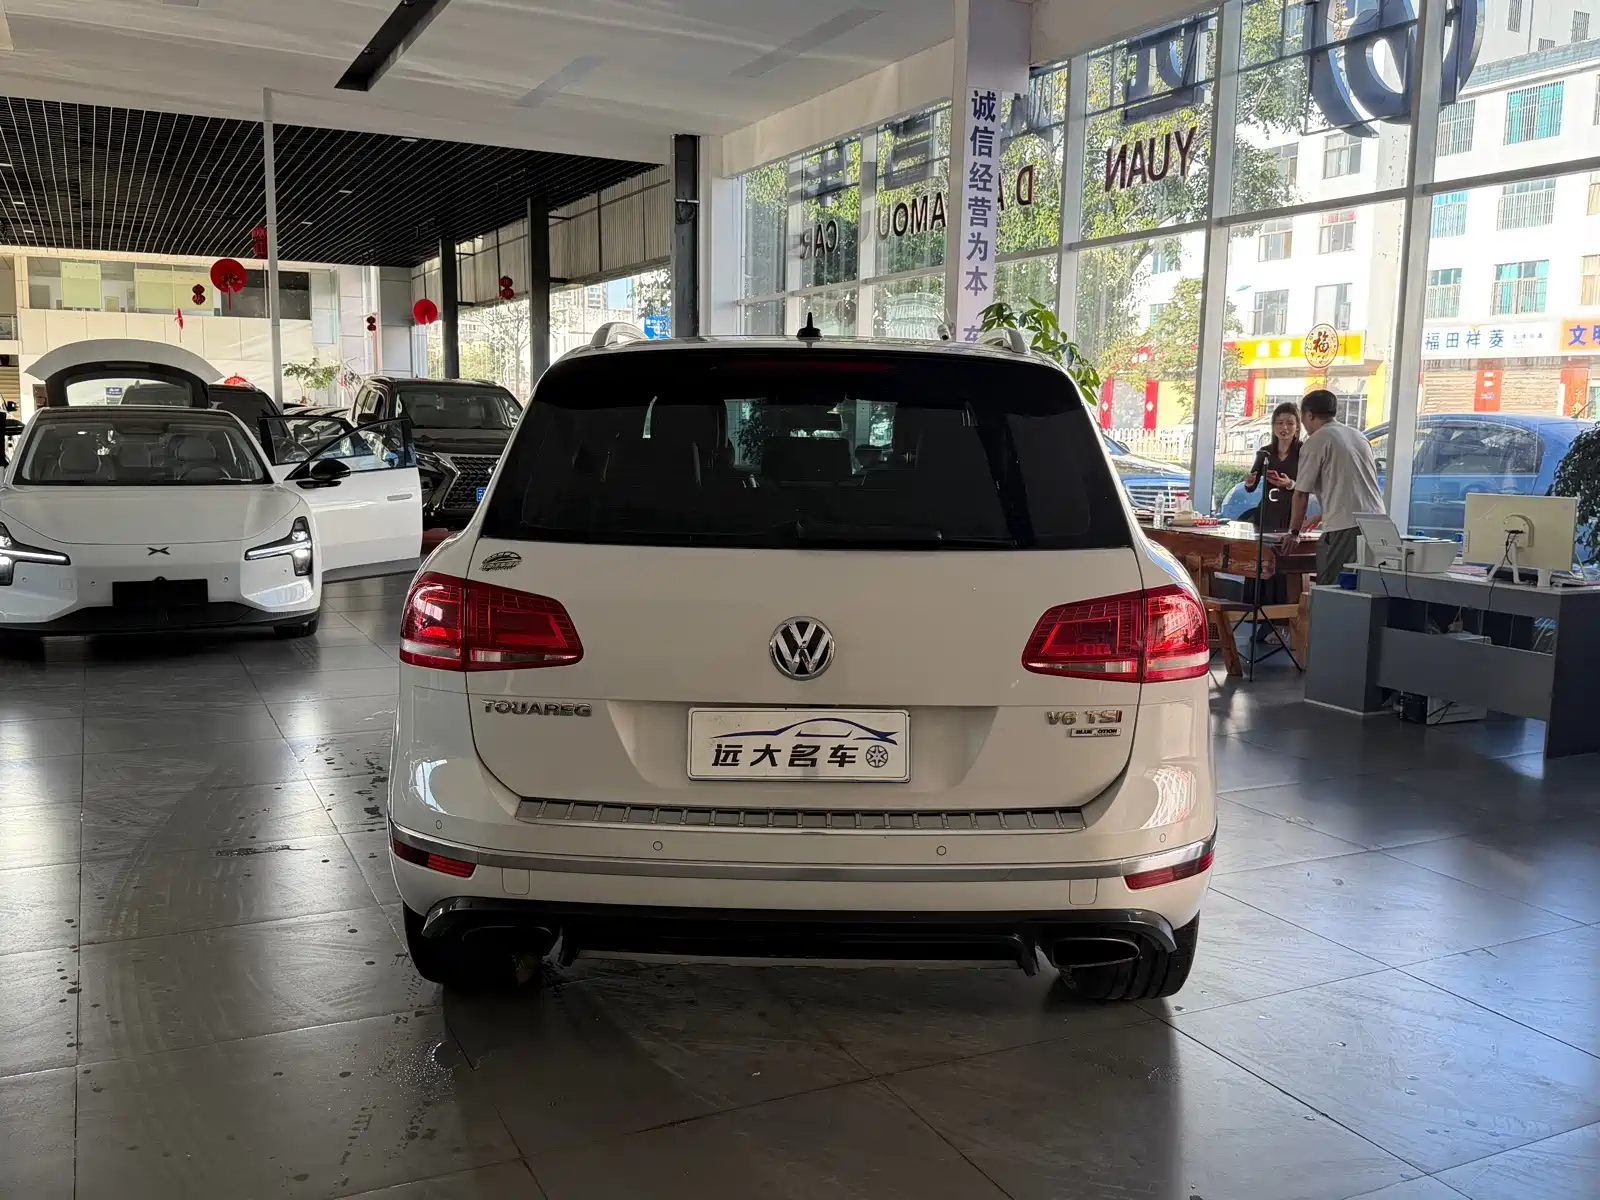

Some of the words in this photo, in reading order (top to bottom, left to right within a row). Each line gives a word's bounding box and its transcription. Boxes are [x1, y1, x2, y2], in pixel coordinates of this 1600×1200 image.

[964, 90, 997, 297] 诚信经营为本
[1424, 329, 1505, 351] 福田祥菱
[481, 699, 593, 717] TOUAREG
[1046, 710, 1078, 725] V6
[1084, 709, 1123, 724] TSI
[1075, 727, 1118, 735] BLUEOTION
[711, 743, 859, 768] 远大名车
